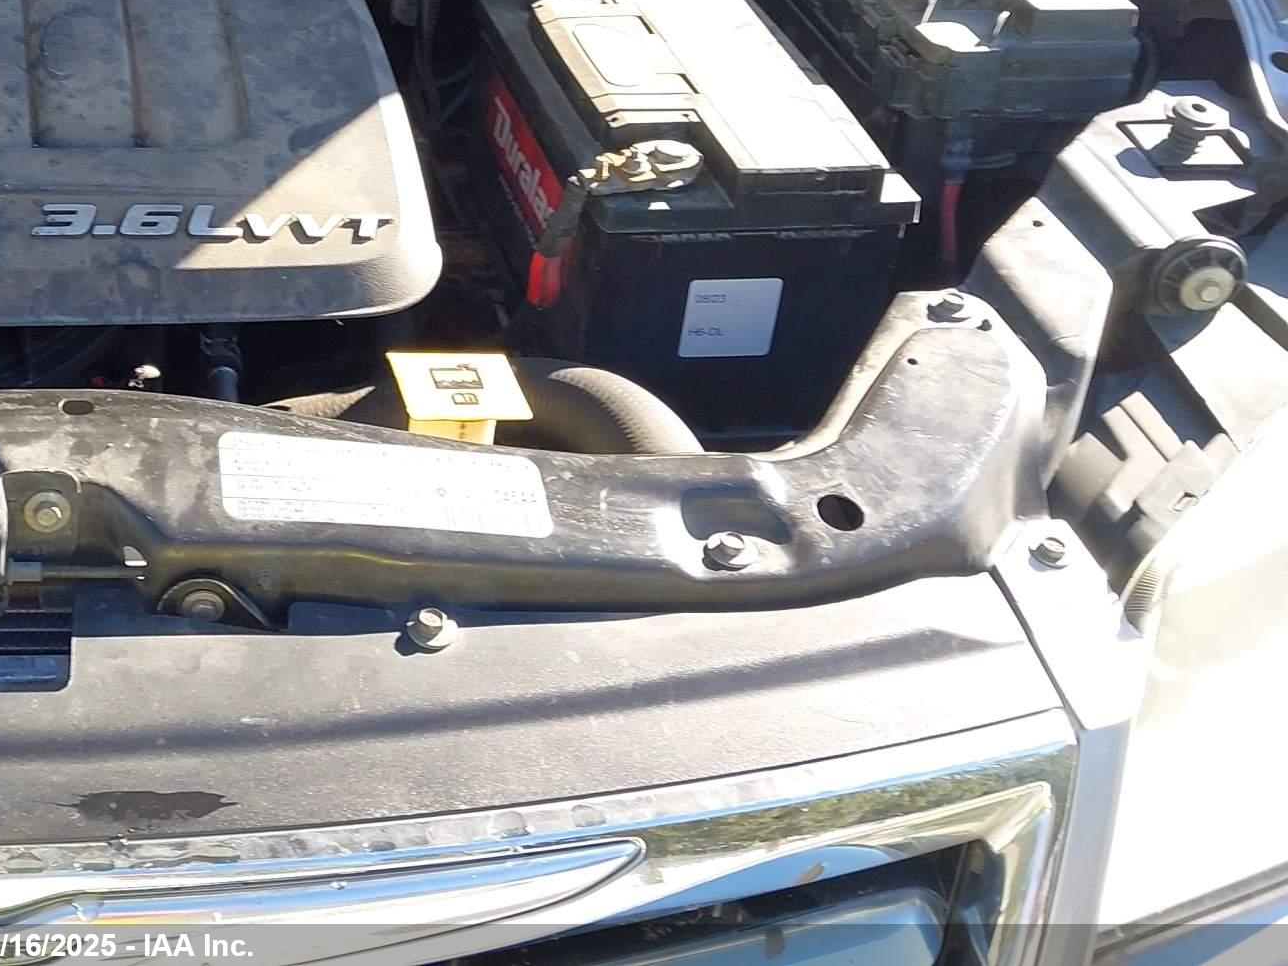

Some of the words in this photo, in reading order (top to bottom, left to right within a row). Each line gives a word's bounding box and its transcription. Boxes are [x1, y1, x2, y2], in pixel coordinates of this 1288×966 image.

[493, 96, 554, 229] Durala
[31, 203, 243, 237] 3.6L
[241, 212, 393, 241] VVT
